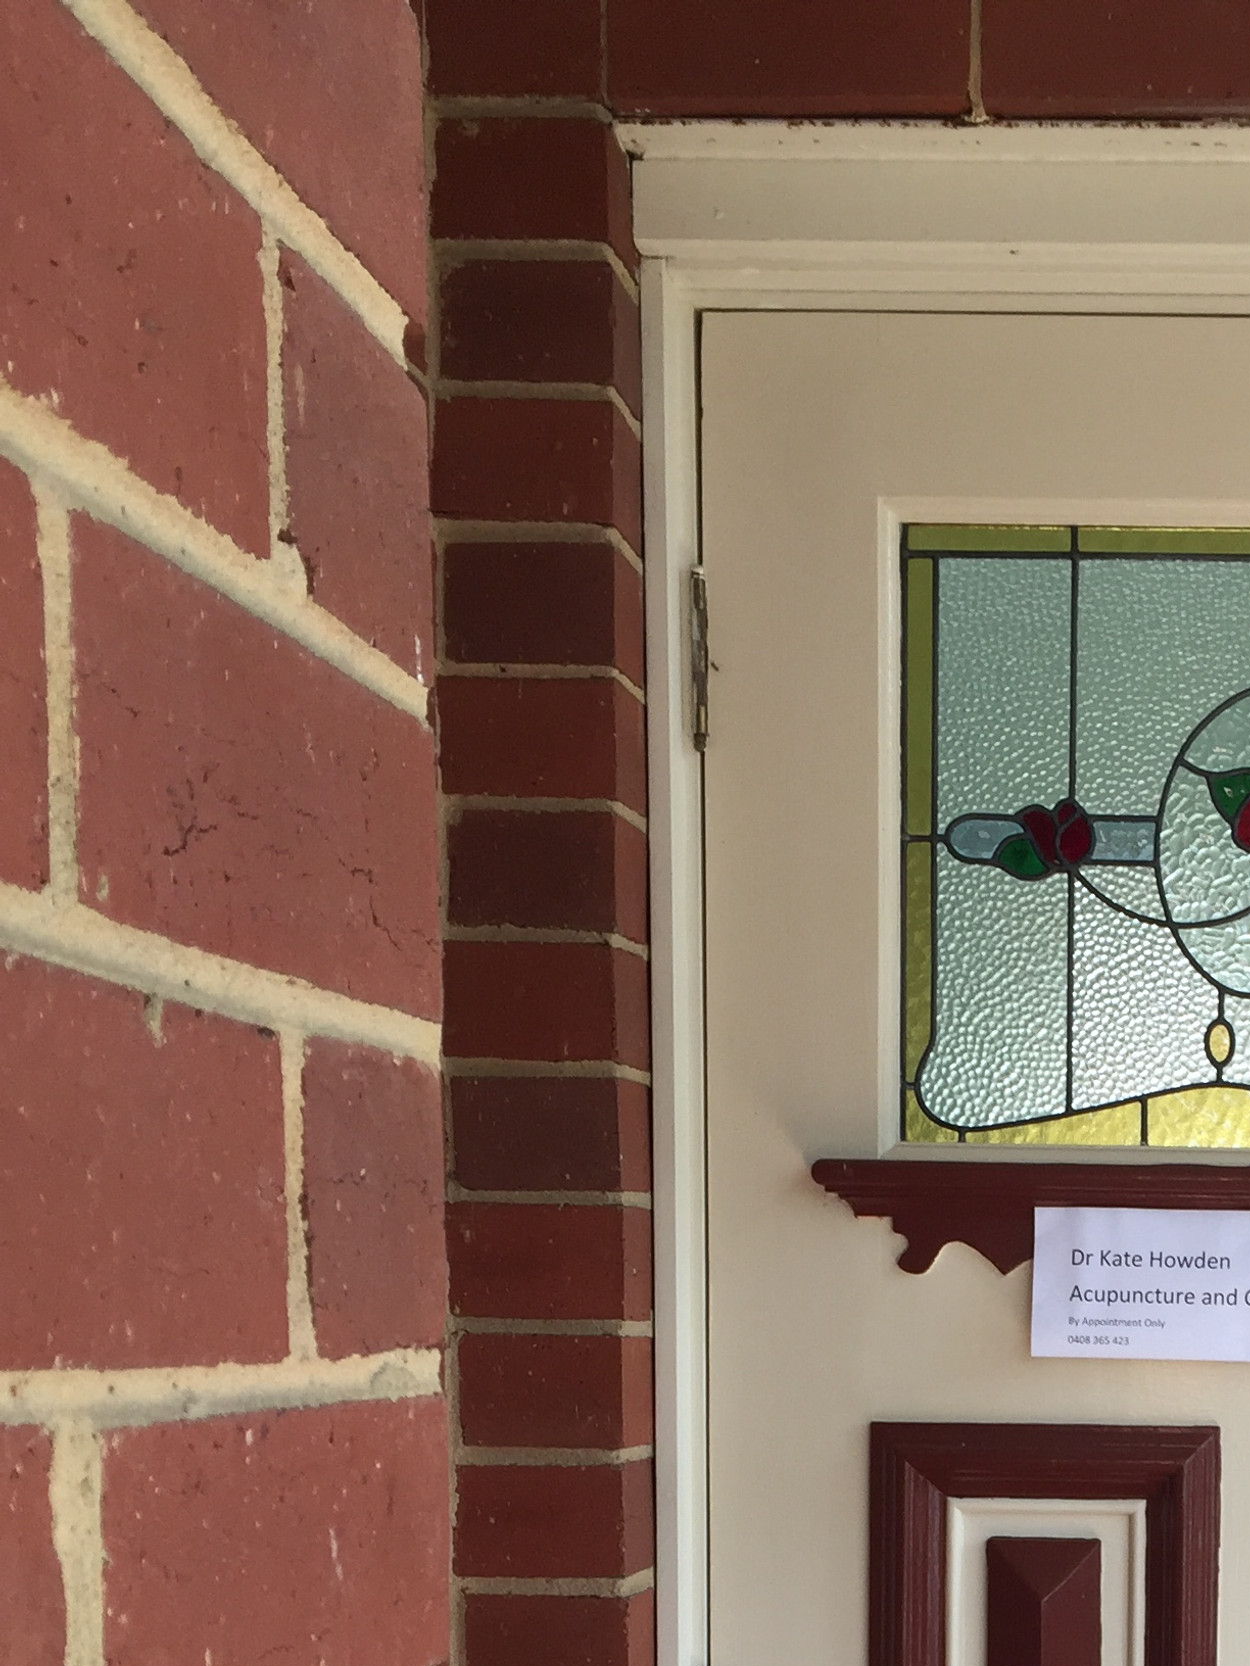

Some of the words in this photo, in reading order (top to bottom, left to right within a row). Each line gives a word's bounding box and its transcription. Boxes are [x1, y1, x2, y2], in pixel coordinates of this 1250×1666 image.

[1071, 1248, 1095, 1267] Dr
[1099, 1249, 1144, 1268] Kate
[1149, 1250, 1231, 1270] Howden
[1069, 1284, 1196, 1307] Acupuncture
[1201, 1287, 1238, 1307] and
[1068, 1316, 1079, 1326] By
[1081, 1317, 1142, 1328] Appointment
[1144, 1318, 1166, 1329] Only
[1067, 1335, 1091, 1345] 0408
